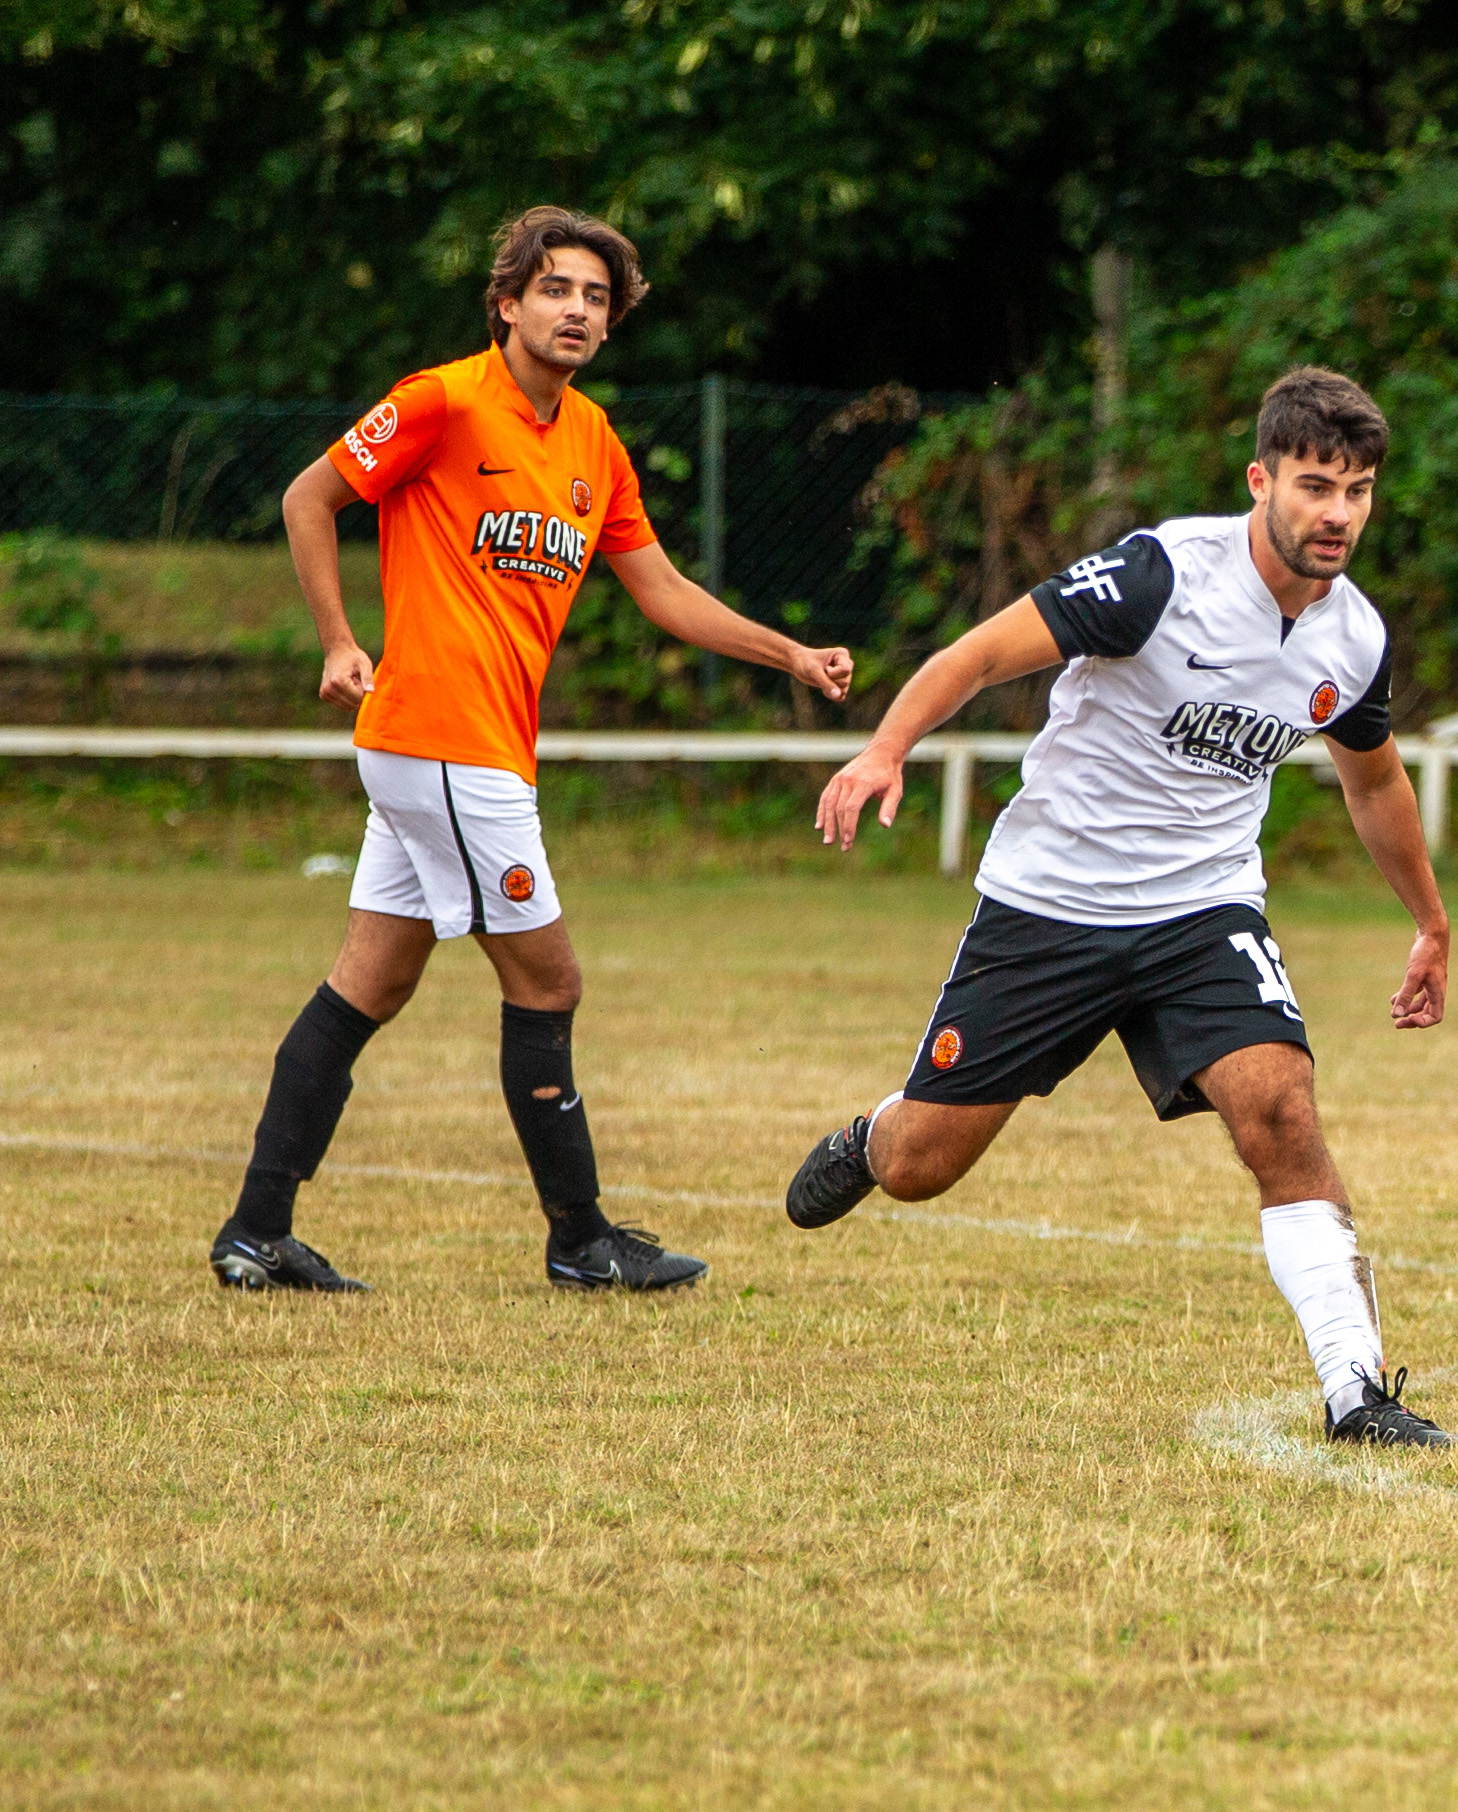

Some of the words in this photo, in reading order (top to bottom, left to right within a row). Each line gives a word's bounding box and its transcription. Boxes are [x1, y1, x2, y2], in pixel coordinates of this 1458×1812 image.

[344, 427, 378, 473] OSCH
[474, 510, 543, 552] MET
[544, 515, 587, 573] ONE
[497, 558, 566, 582] CREATIVE
[1164, 701, 1257, 748] MET
[1188, 745, 1259, 778] CREATIV
